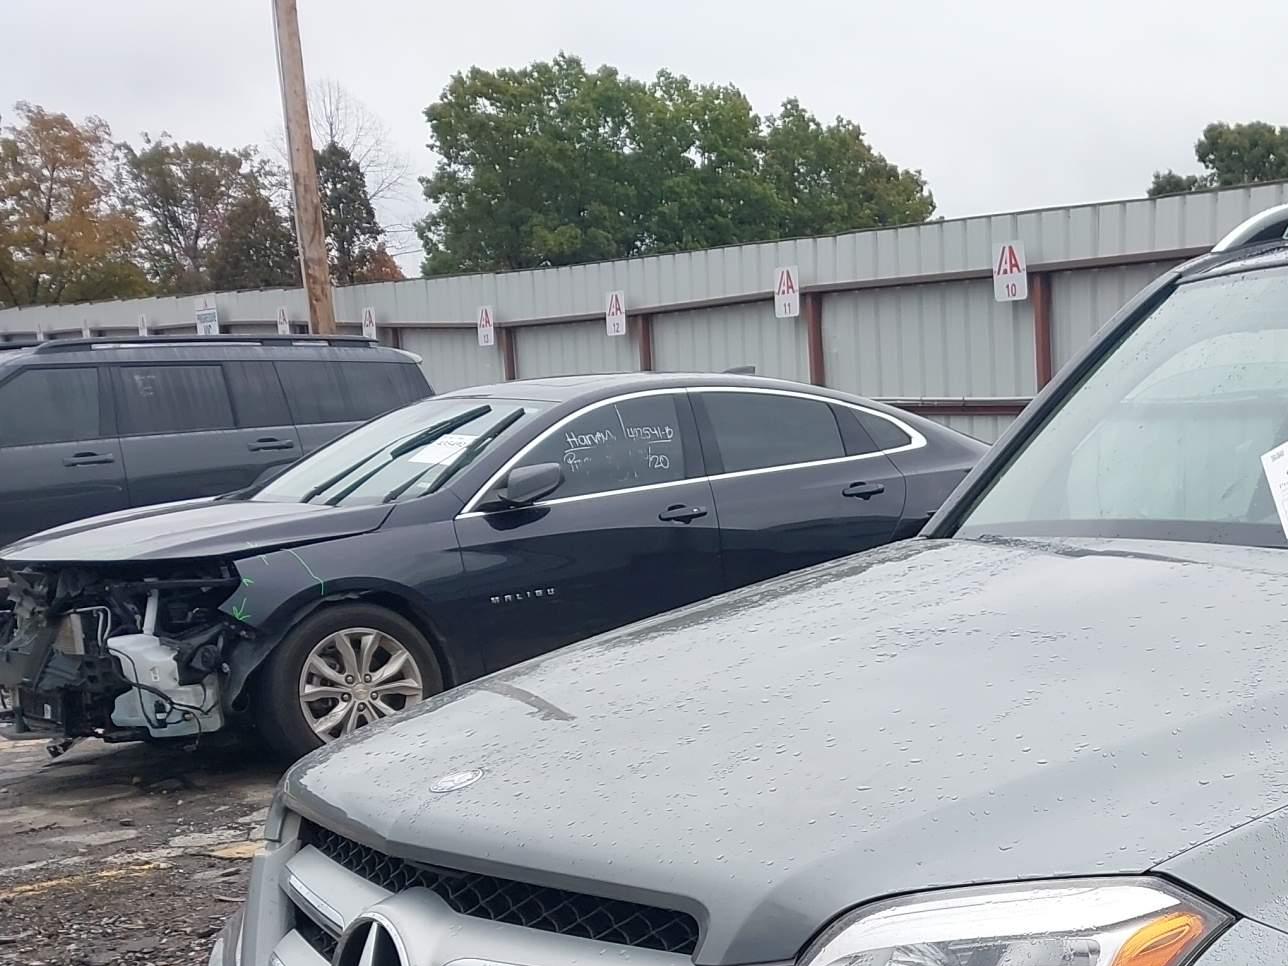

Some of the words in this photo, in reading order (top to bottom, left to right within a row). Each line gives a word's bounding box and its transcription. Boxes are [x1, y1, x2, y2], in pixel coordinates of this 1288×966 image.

[1005, 283, 1017, 298] 10
[783, 302, 791, 314] 11
[490, 587, 555, 604] MALIBU
